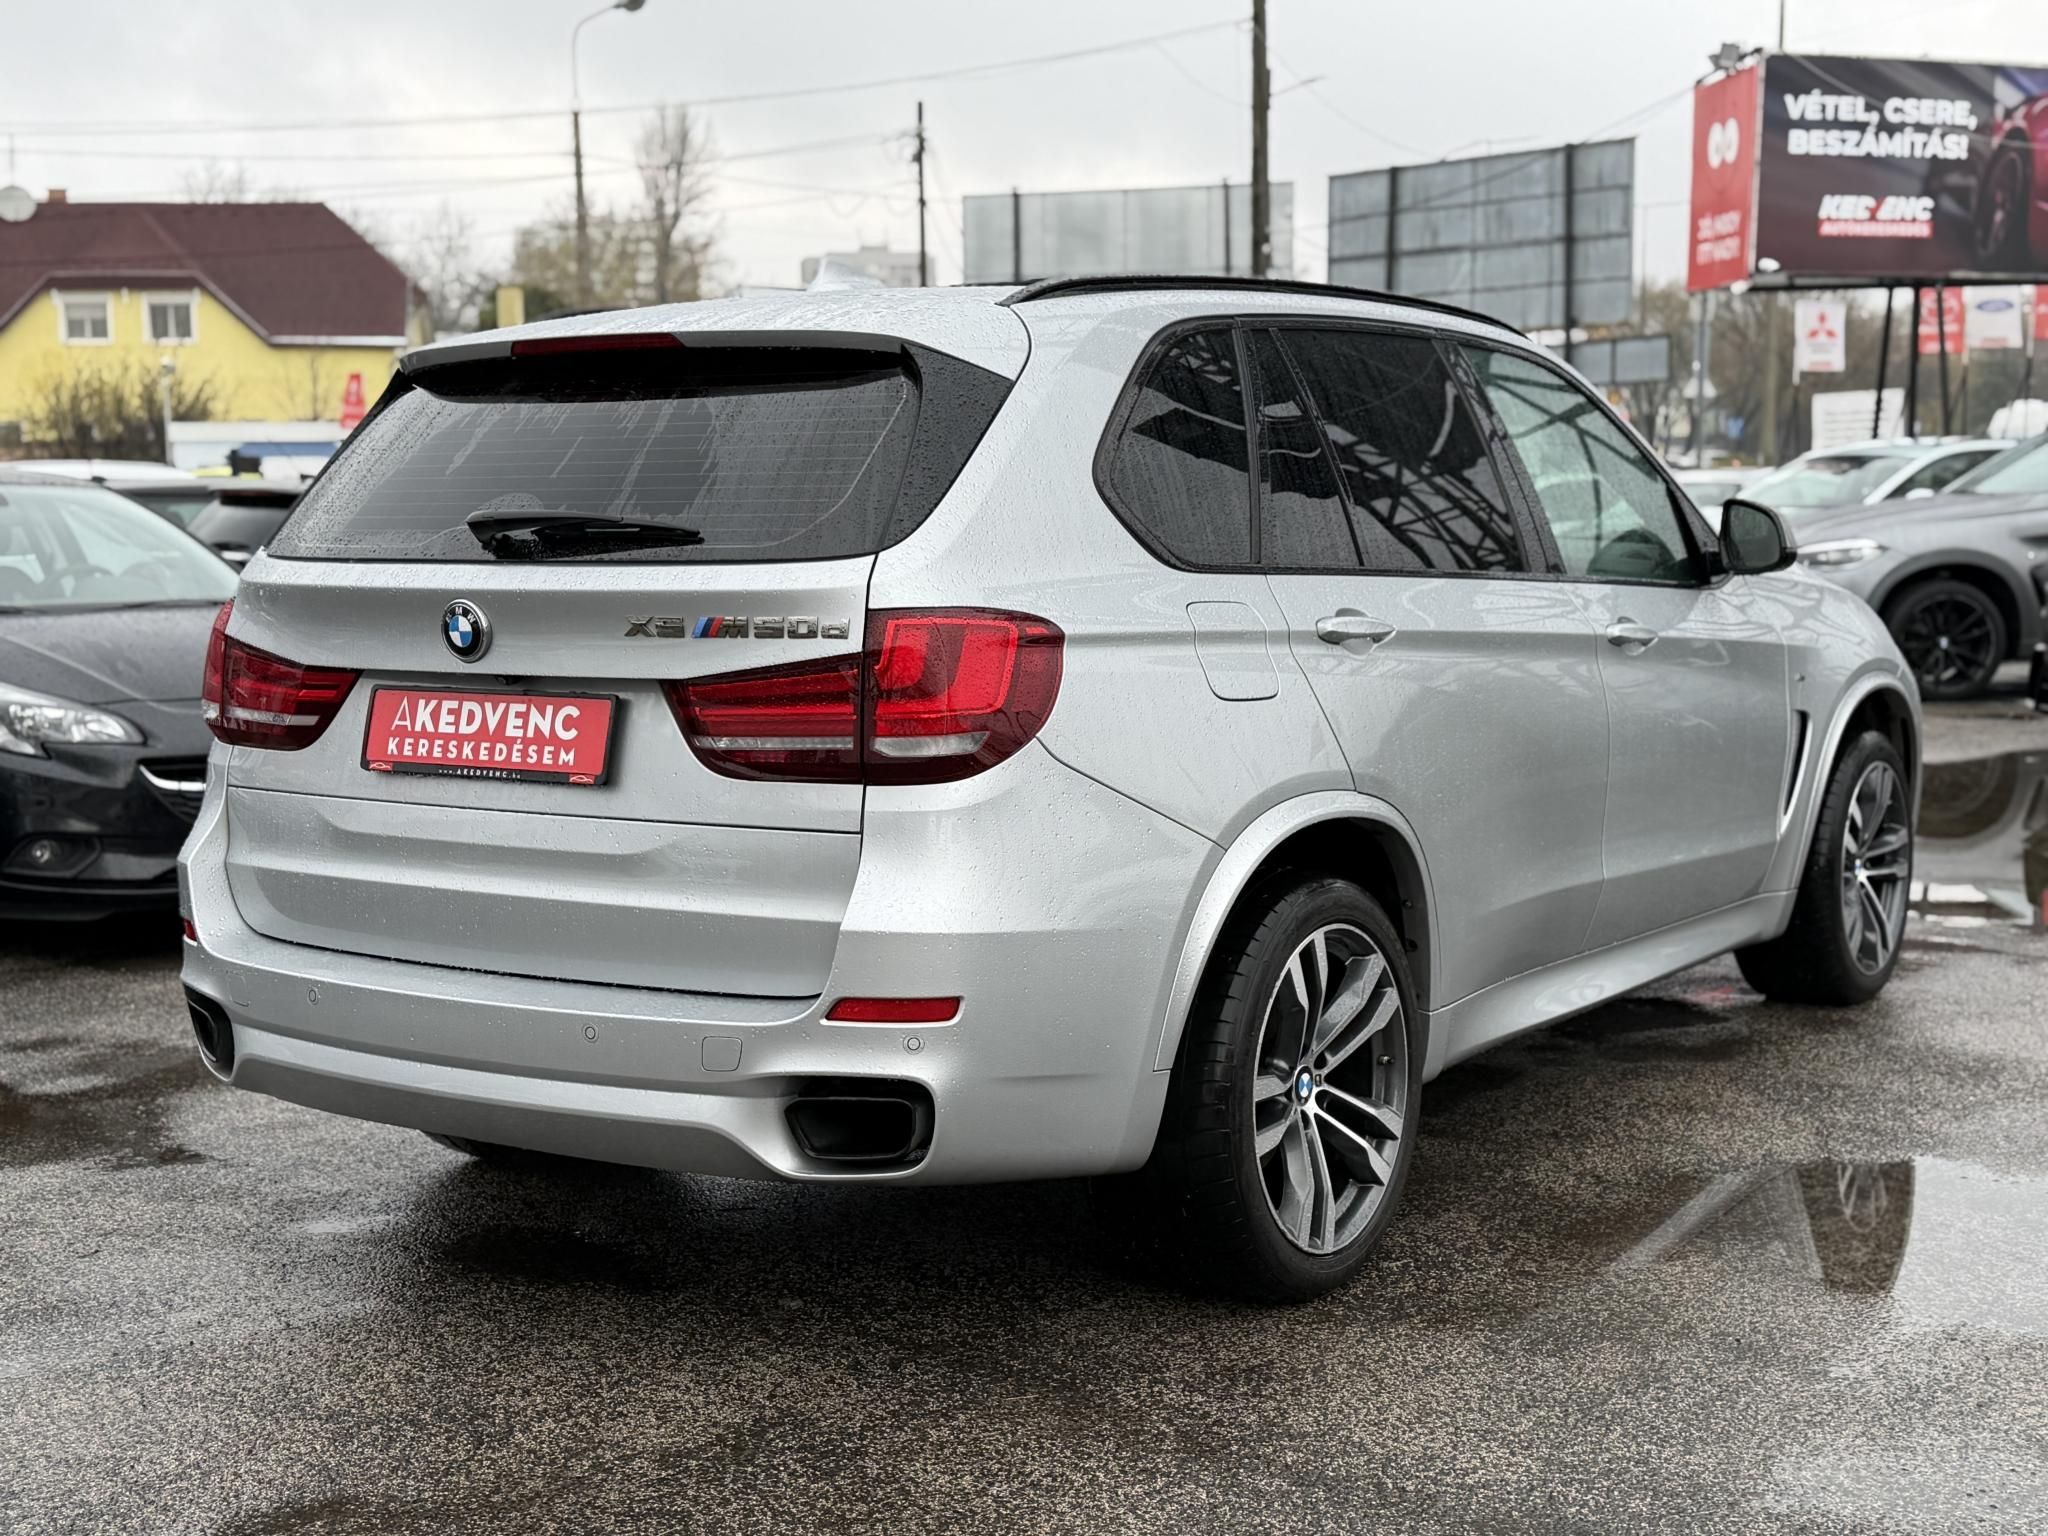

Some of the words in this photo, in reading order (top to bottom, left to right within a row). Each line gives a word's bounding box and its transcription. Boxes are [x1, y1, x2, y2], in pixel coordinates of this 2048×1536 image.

[1784, 88, 1880, 126] VÉTEL,
[1884, 97, 1978, 131] CSERE,
[1788, 126, 1970, 160] BESZÁMÍTÁS!
[446, 606, 476, 623] BMW
[624, 616, 685, 637] X5
[387, 737, 575, 766] KERESKEDÉSEM
